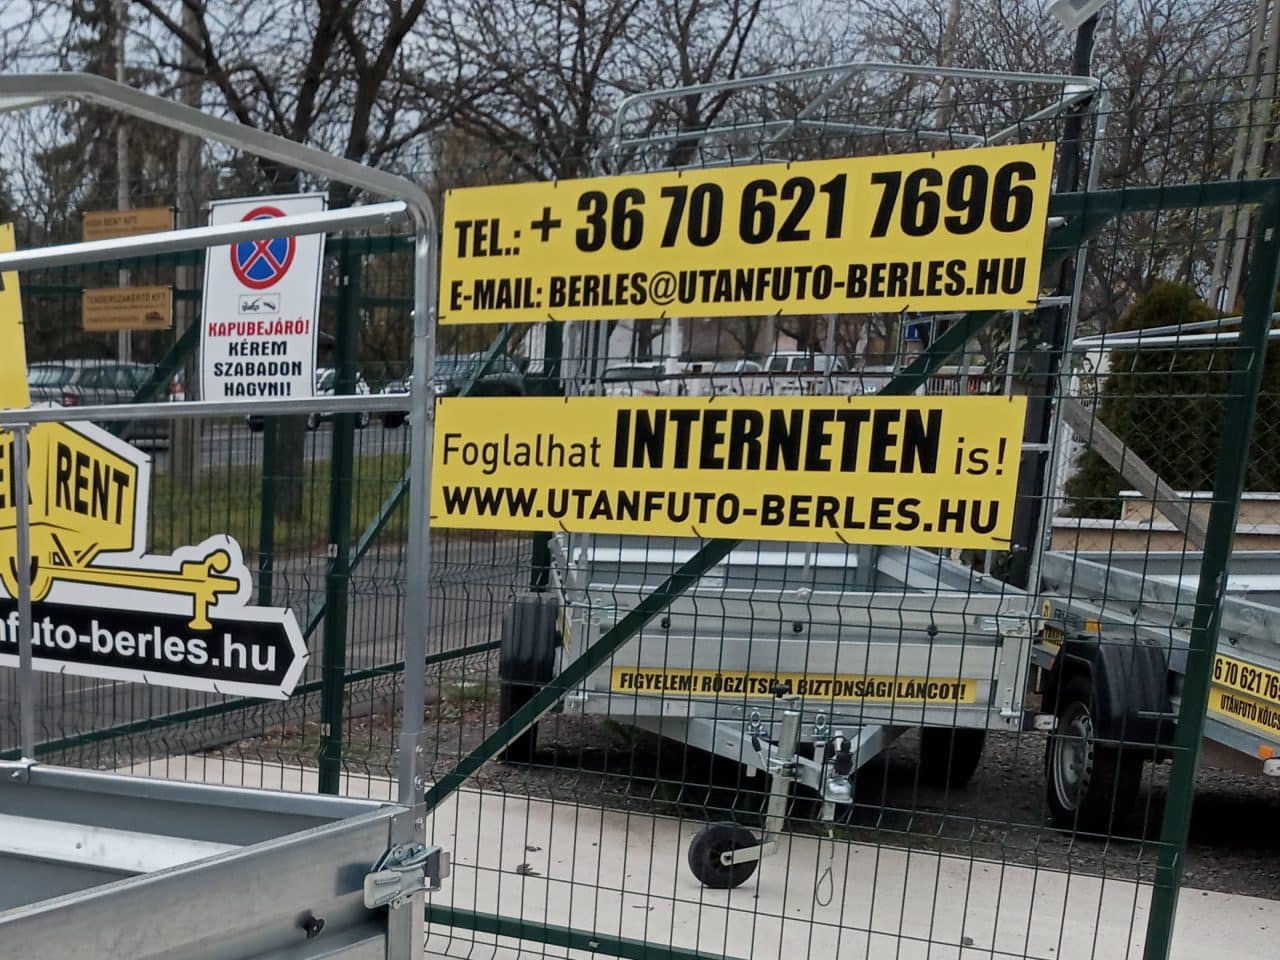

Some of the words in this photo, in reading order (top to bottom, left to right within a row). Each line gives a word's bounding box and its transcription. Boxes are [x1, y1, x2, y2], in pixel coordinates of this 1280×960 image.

[454, 218, 521, 259] TEL.:
[575, 189, 646, 253] 36
[660, 183, 724, 248] 70
[739, 172, 848, 245] 621
[869, 160, 1037, 239] 7696
[450, 277, 543, 311] E-MAIL:
[548, 257, 1027, 308] BERLES@UTANFUTO-BERLES.HU
[208, 316, 310, 337] KAPUBEJÁRÓ!
[228, 338, 288, 357] KÉREM
[214, 361, 302, 377] SZABADON
[224, 381, 292, 397] HAGYNI!
[442, 433, 601, 475] Foglalhat
[613, 409, 943, 474] INTERNETEN
[953, 437, 1008, 476] is!
[55, 442, 130, 525] RENT
[442, 486, 1000, 534] WWW.UTANFUTO-BERLES.HU
[620, 672, 699, 692] FIGYELEM!
[797, 677, 893, 698] BIZTONSÁGI
[896, 678, 966, 700] LÁNCOT!
[1224, 661, 1239, 685] 70
[1240, 666, 1262, 693] 621
[1264, 673, 1280, 699] 76
[1220, 693, 1257, 721] UTÁNFUTÓ
